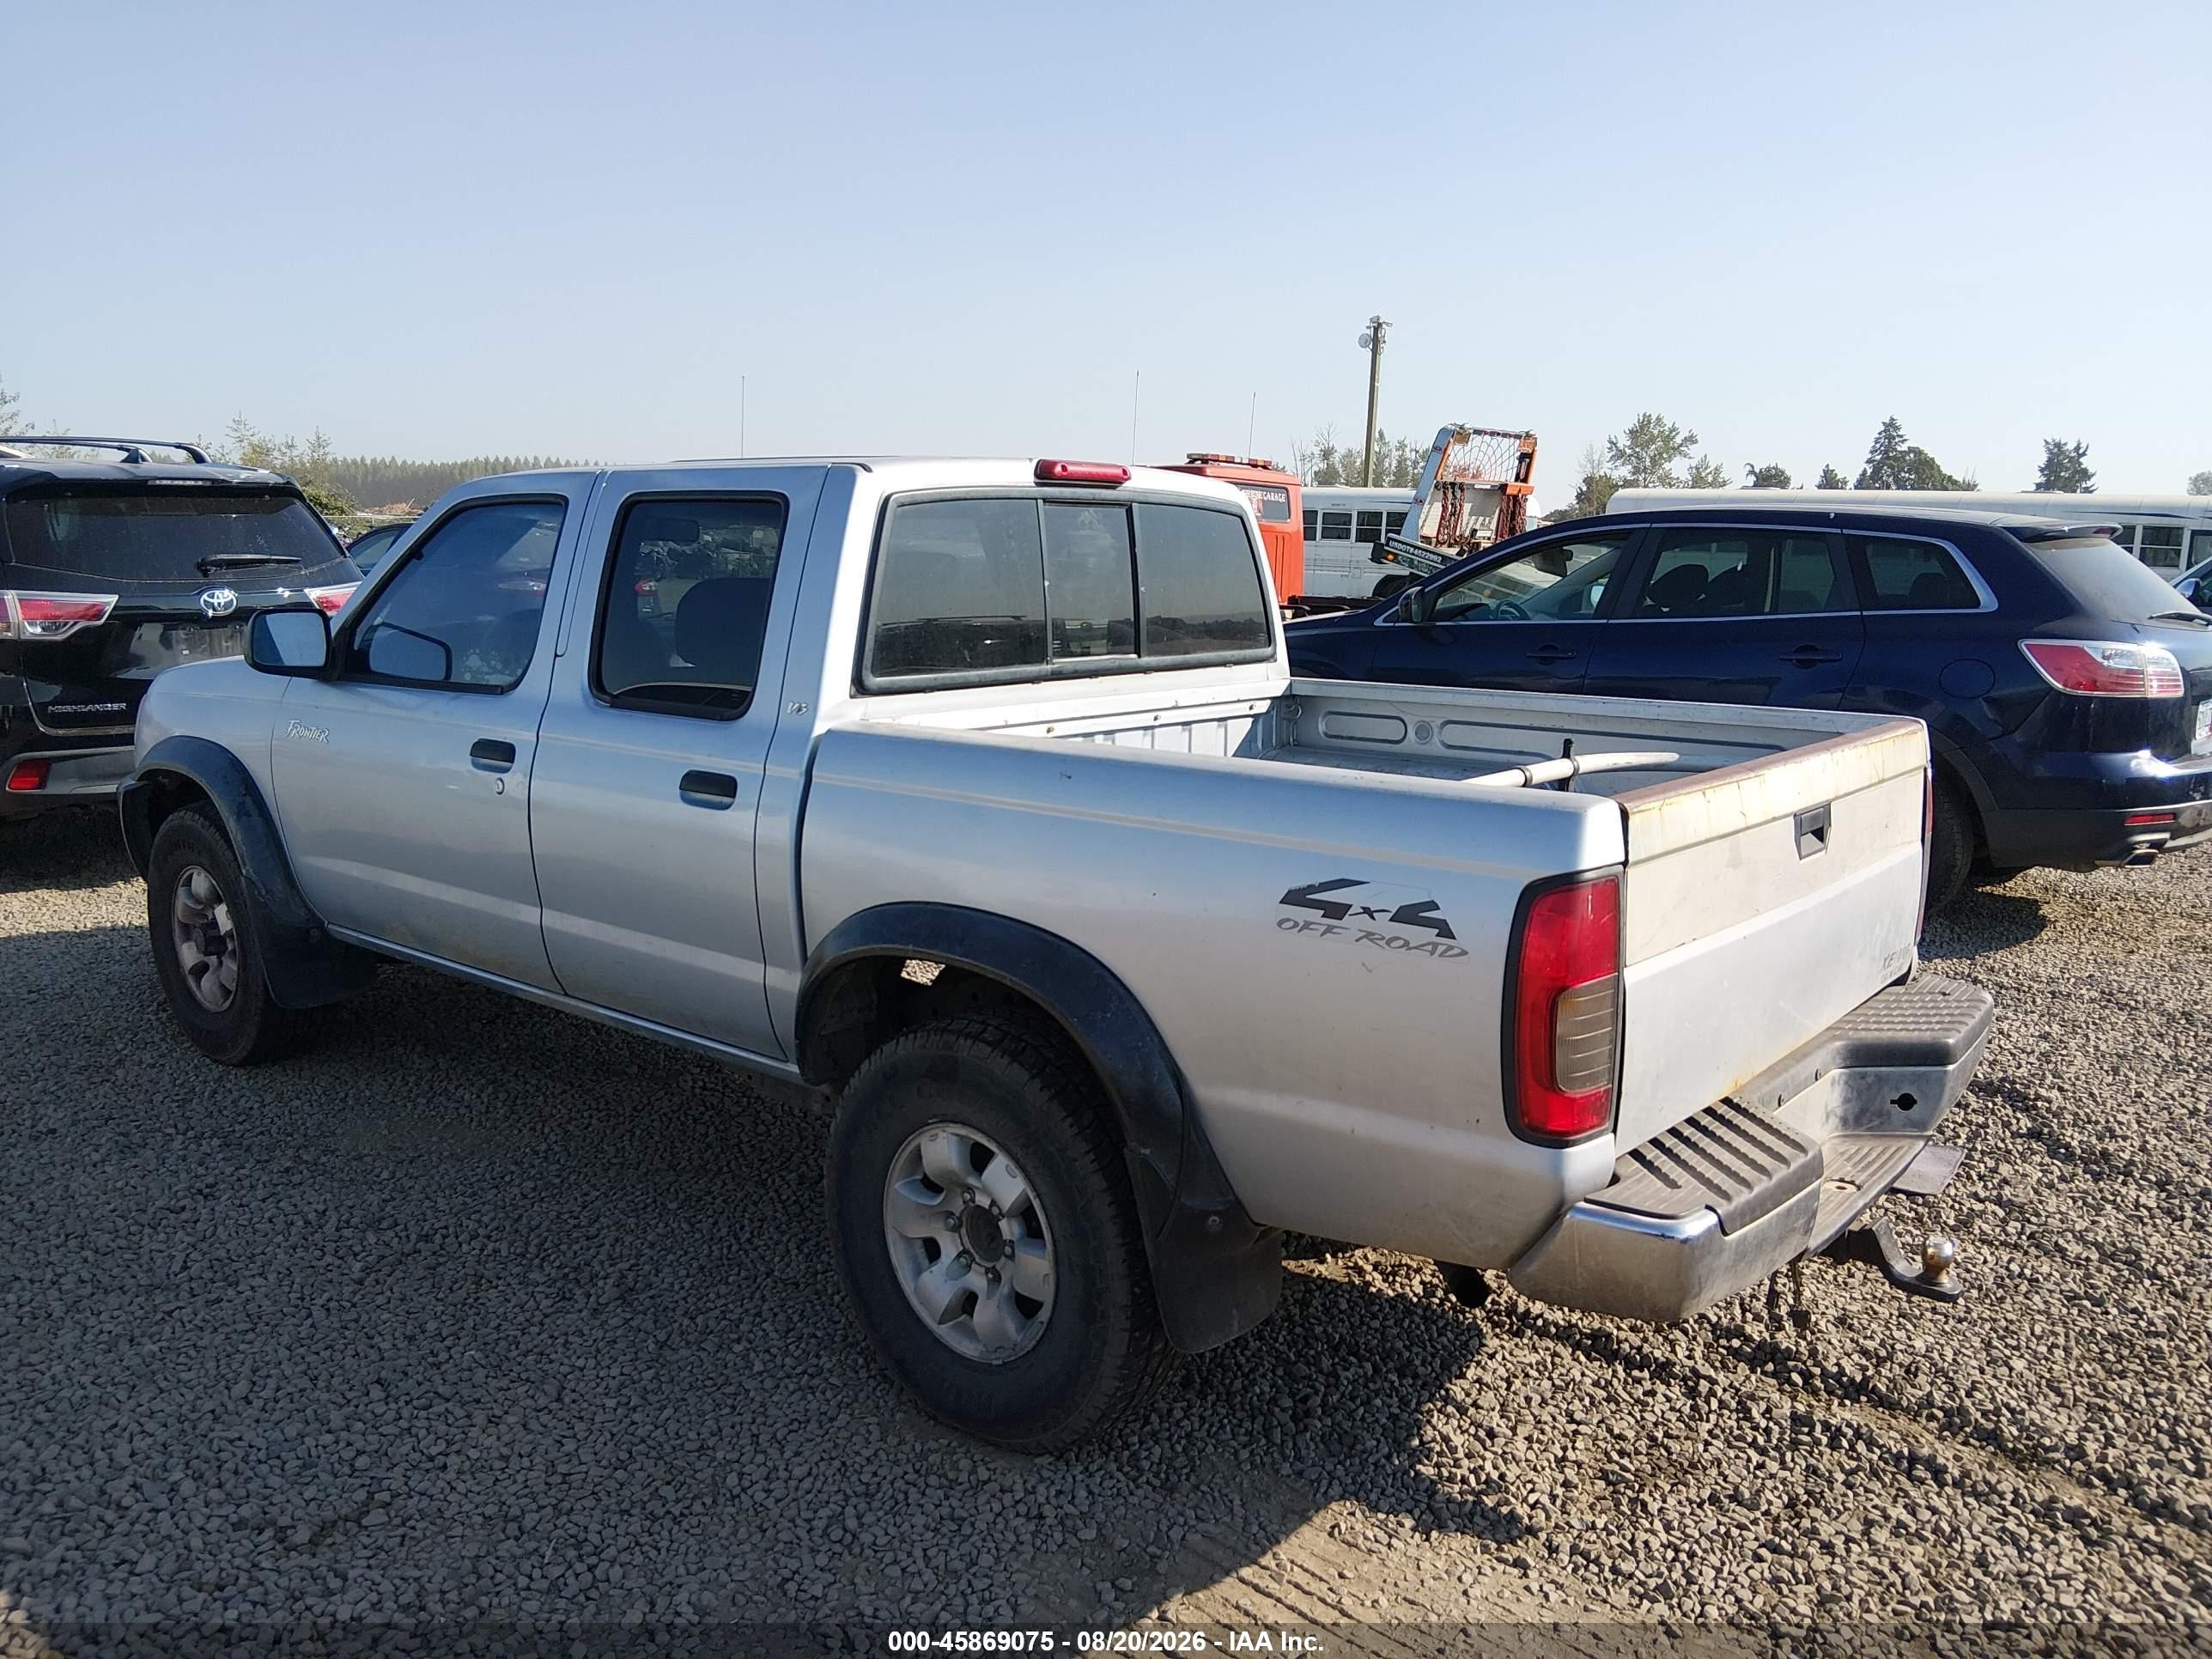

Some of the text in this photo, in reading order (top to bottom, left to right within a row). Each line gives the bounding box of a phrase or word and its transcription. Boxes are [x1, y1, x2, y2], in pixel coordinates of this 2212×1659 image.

[1263, 491, 1286, 502] GARAGE
[47, 702, 127, 714] HIGHLANDER
[1276, 916, 1469, 958] OFF ROAD
